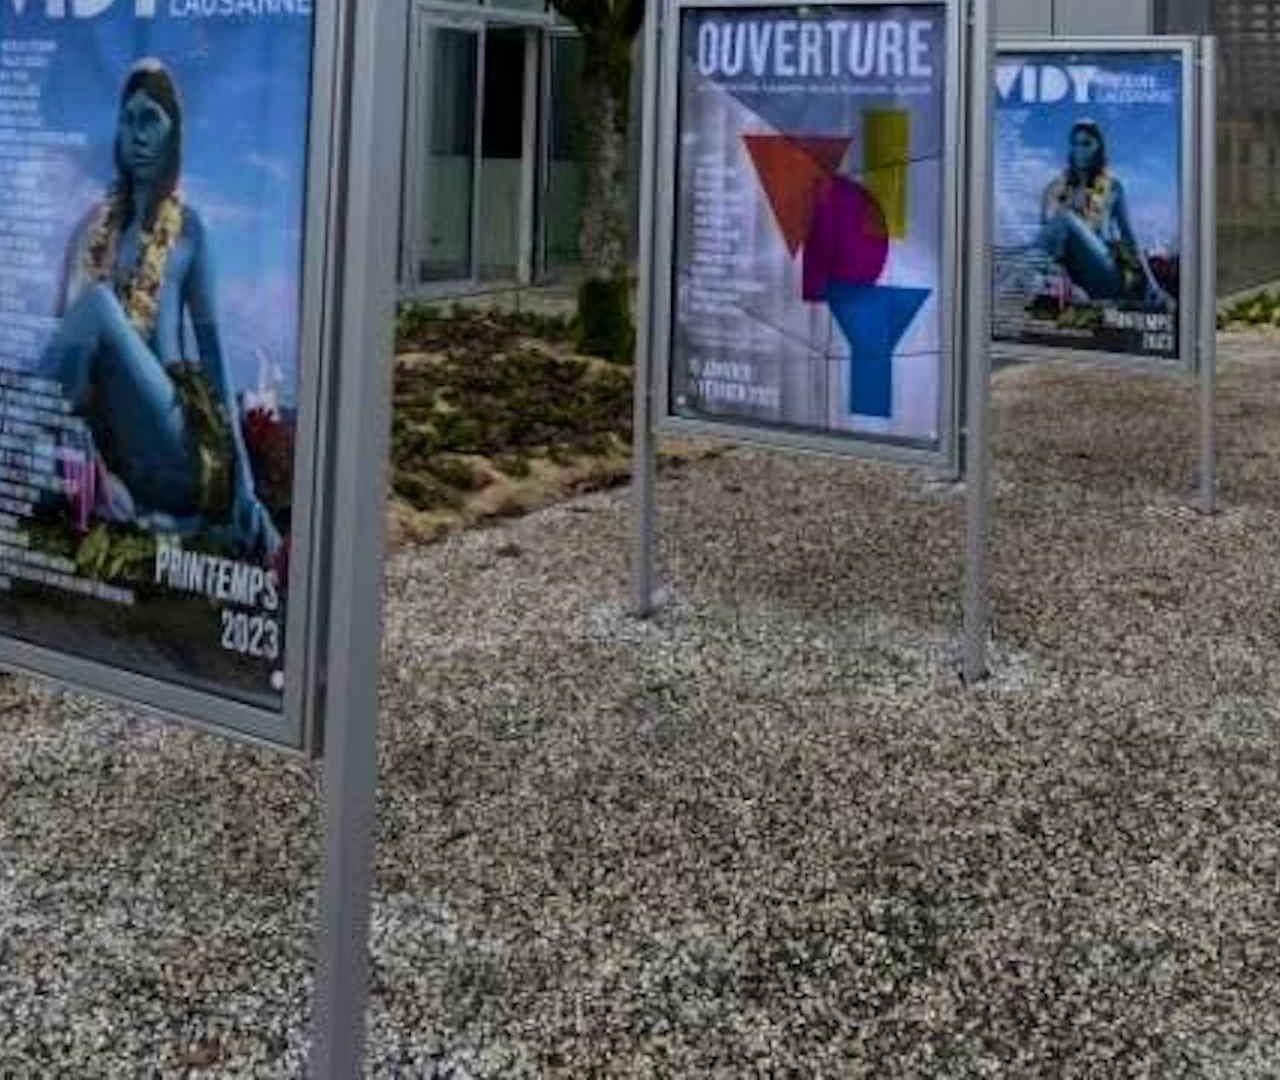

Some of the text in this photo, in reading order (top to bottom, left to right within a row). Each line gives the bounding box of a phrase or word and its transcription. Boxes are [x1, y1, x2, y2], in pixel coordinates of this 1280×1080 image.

[698, 20, 933, 77] OUVERTURE
[995, 64, 1099, 103] VIDY
[155, 548, 279, 610] PRINTEMPS
[221, 610, 279, 659] 2023
